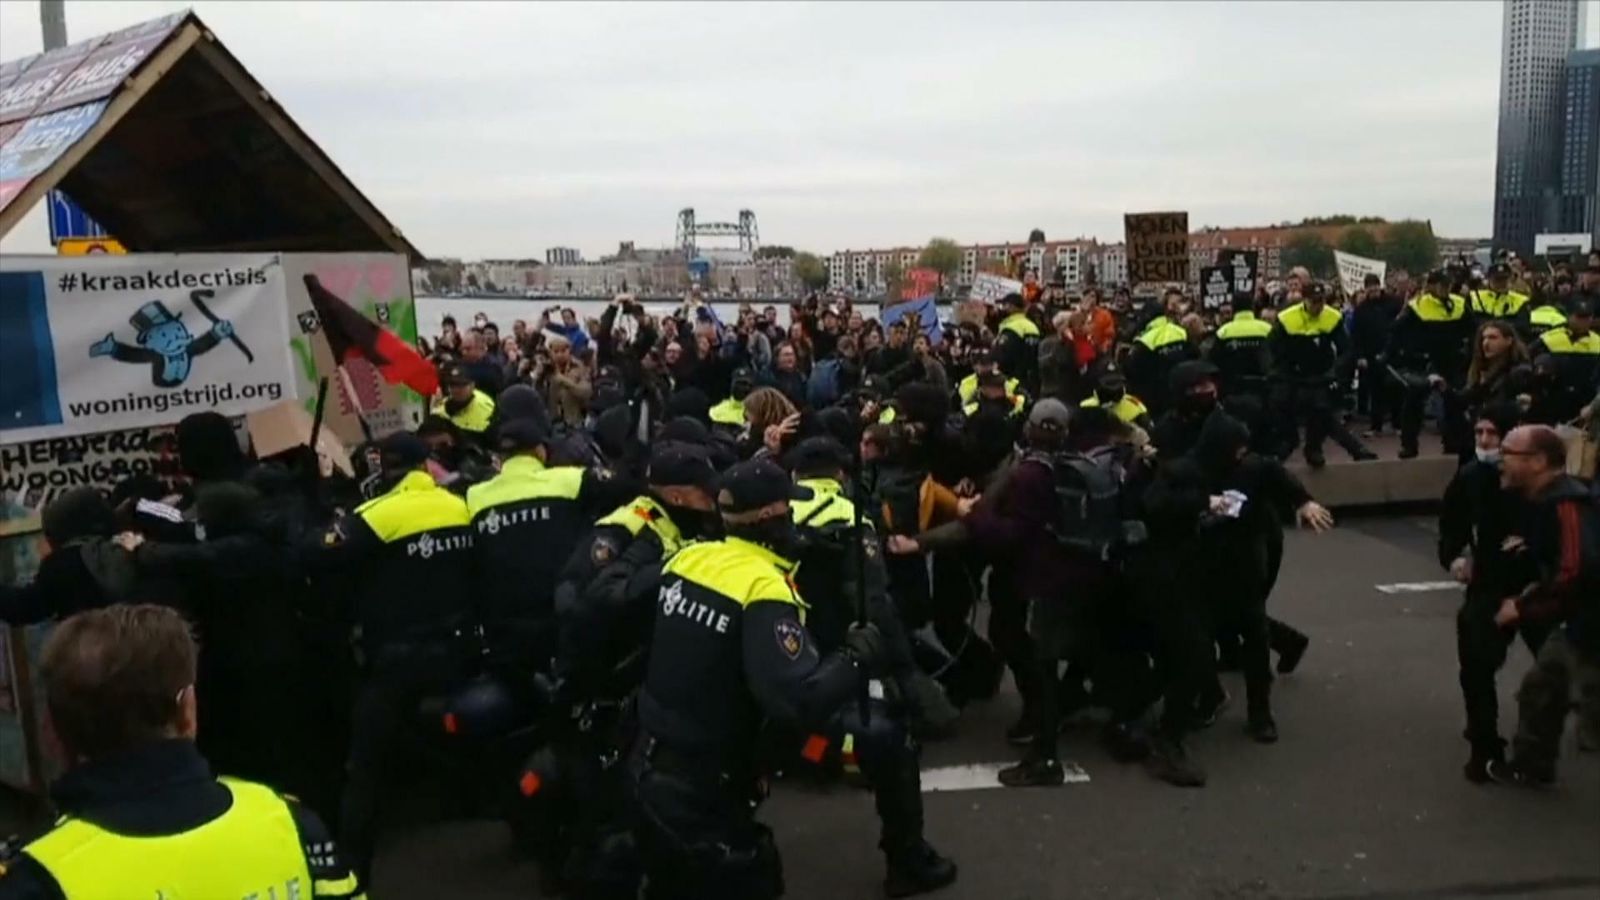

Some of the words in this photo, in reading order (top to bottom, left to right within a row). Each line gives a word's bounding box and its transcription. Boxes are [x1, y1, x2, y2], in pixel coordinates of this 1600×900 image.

[59, 268, 267, 292] #kraakdecrisis
[1128, 259, 1189, 281] RECHT
[69, 382, 282, 417] woningstrijd.org
[477, 507, 550, 535] POLITIE
[658, 580, 730, 633] POLITIE
